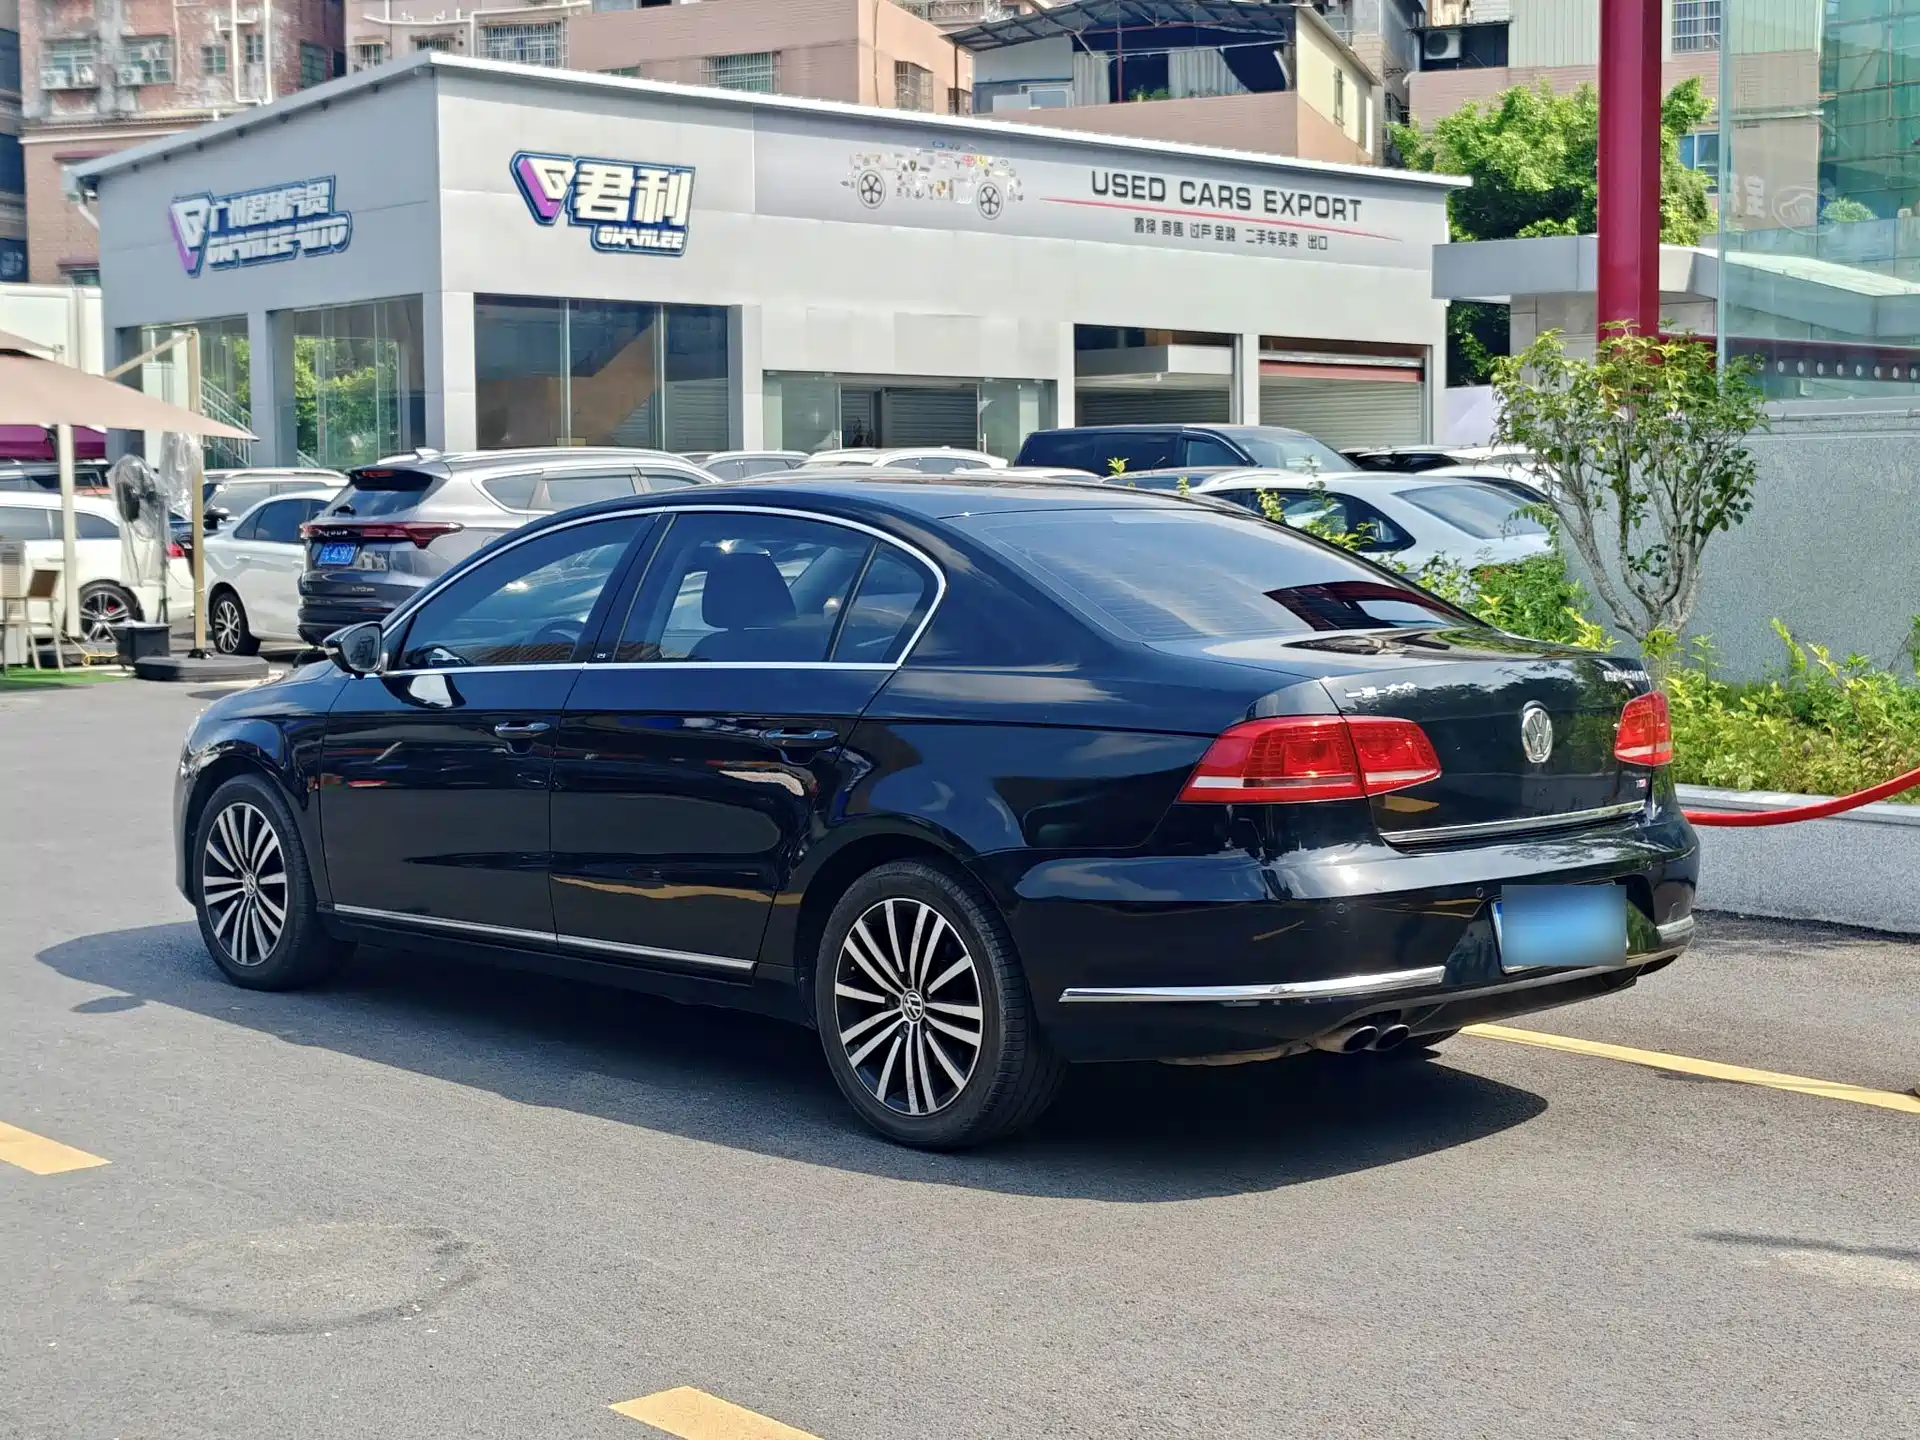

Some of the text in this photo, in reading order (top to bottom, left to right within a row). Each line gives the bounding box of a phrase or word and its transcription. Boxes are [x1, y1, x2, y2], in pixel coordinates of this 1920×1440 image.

[574, 163, 693, 226] 君利
[1091, 170, 1362, 222] USED CARS EXPORT
[1245, 228, 1299, 249] 二手车买卖
[1307, 232, 1328, 251] 出口
